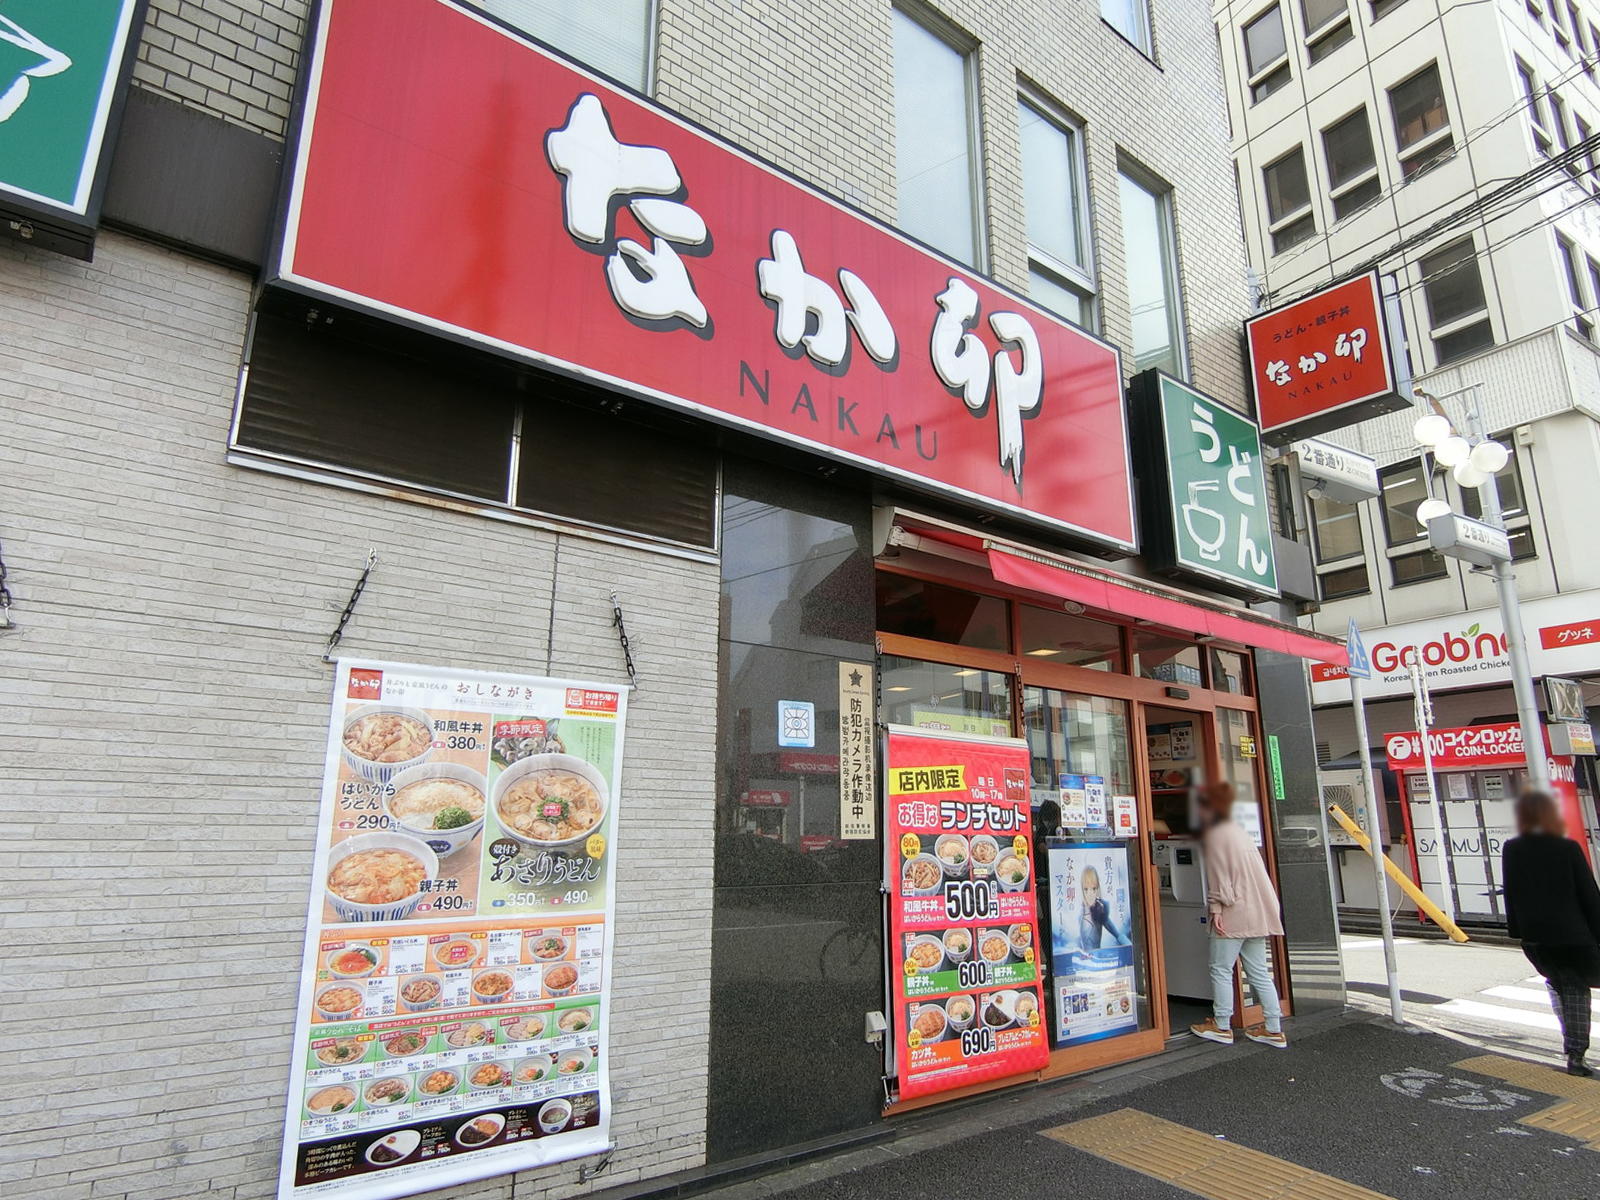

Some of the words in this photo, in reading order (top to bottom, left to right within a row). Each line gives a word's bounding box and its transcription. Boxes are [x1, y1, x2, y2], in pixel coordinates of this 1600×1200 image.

[545, 92, 1044, 494] なか卯
[1273, 305, 1351, 343] うどん・親子丼
[1265, 327, 1367, 386] なか卯
[1288, 371, 1353, 399] NAKAU
[740, 359, 938, 461] NAKAU
[1302, 443, 1345, 472] 2番通り
[1190, 401, 1268, 577] うどん
[1462, 524, 1491, 545] 2番通り
[1440, 664, 1478, 676] Roasted
[350, 676, 381, 690] なか卯
[457, 681, 533, 701] おしながき
[433, 719, 483, 734] 和風牛丼
[499, 722, 545, 736] 季節限定
[1444, 726, 1524, 747] コインロッカ
[850, 698, 864, 820] 防犯カメラ作動中
[341, 782, 396, 796] はいから
[898, 768, 961, 792] 店内限定
[340, 797, 380, 811] うどん
[897, 801, 940, 828] お得な
[940, 800, 1028, 831] ランチセット
[902, 836, 920, 849] 80円
[490, 852, 601, 886] あさりうどん
[419, 879, 458, 893] 親子丼
